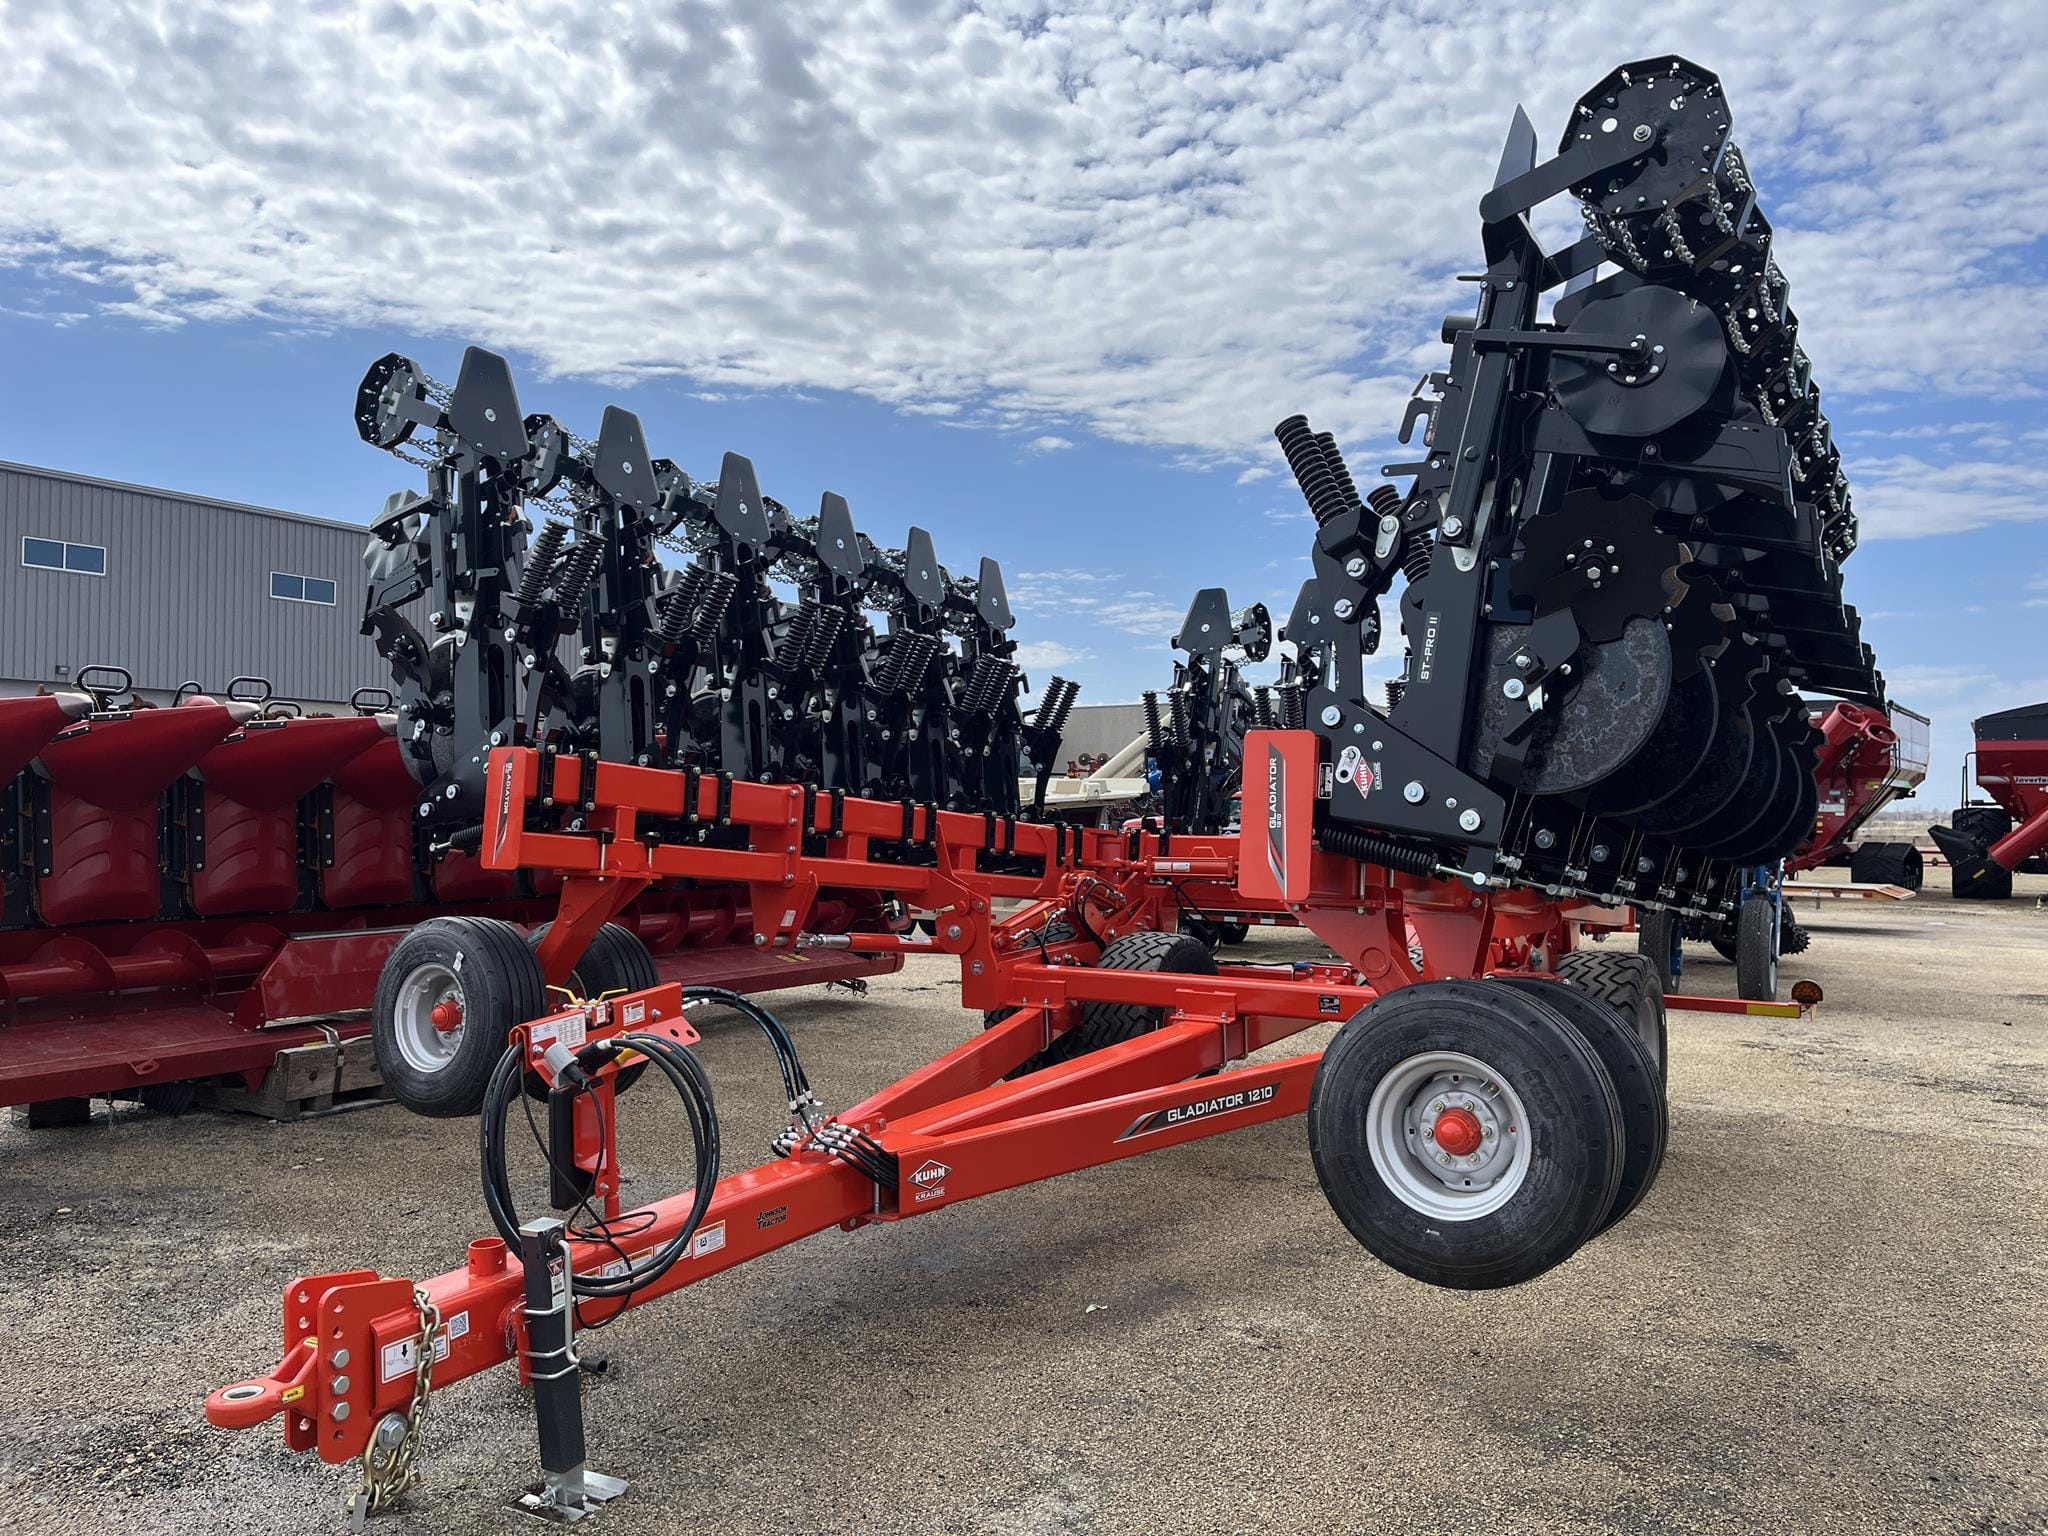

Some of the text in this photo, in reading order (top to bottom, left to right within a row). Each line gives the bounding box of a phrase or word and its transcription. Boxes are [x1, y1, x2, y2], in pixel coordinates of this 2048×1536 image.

[1420, 616, 1438, 680] ST-PRO II
[503, 762, 513, 814] GLADIATOR
[1269, 757, 1277, 829] GLADIATOR
[1359, 763, 1368, 792] KUHN
[1167, 1086, 1273, 1122] GLADIATOR 1210
[915, 1166, 945, 1183] KUHN
[915, 1188, 945, 1201] KRAUSE
